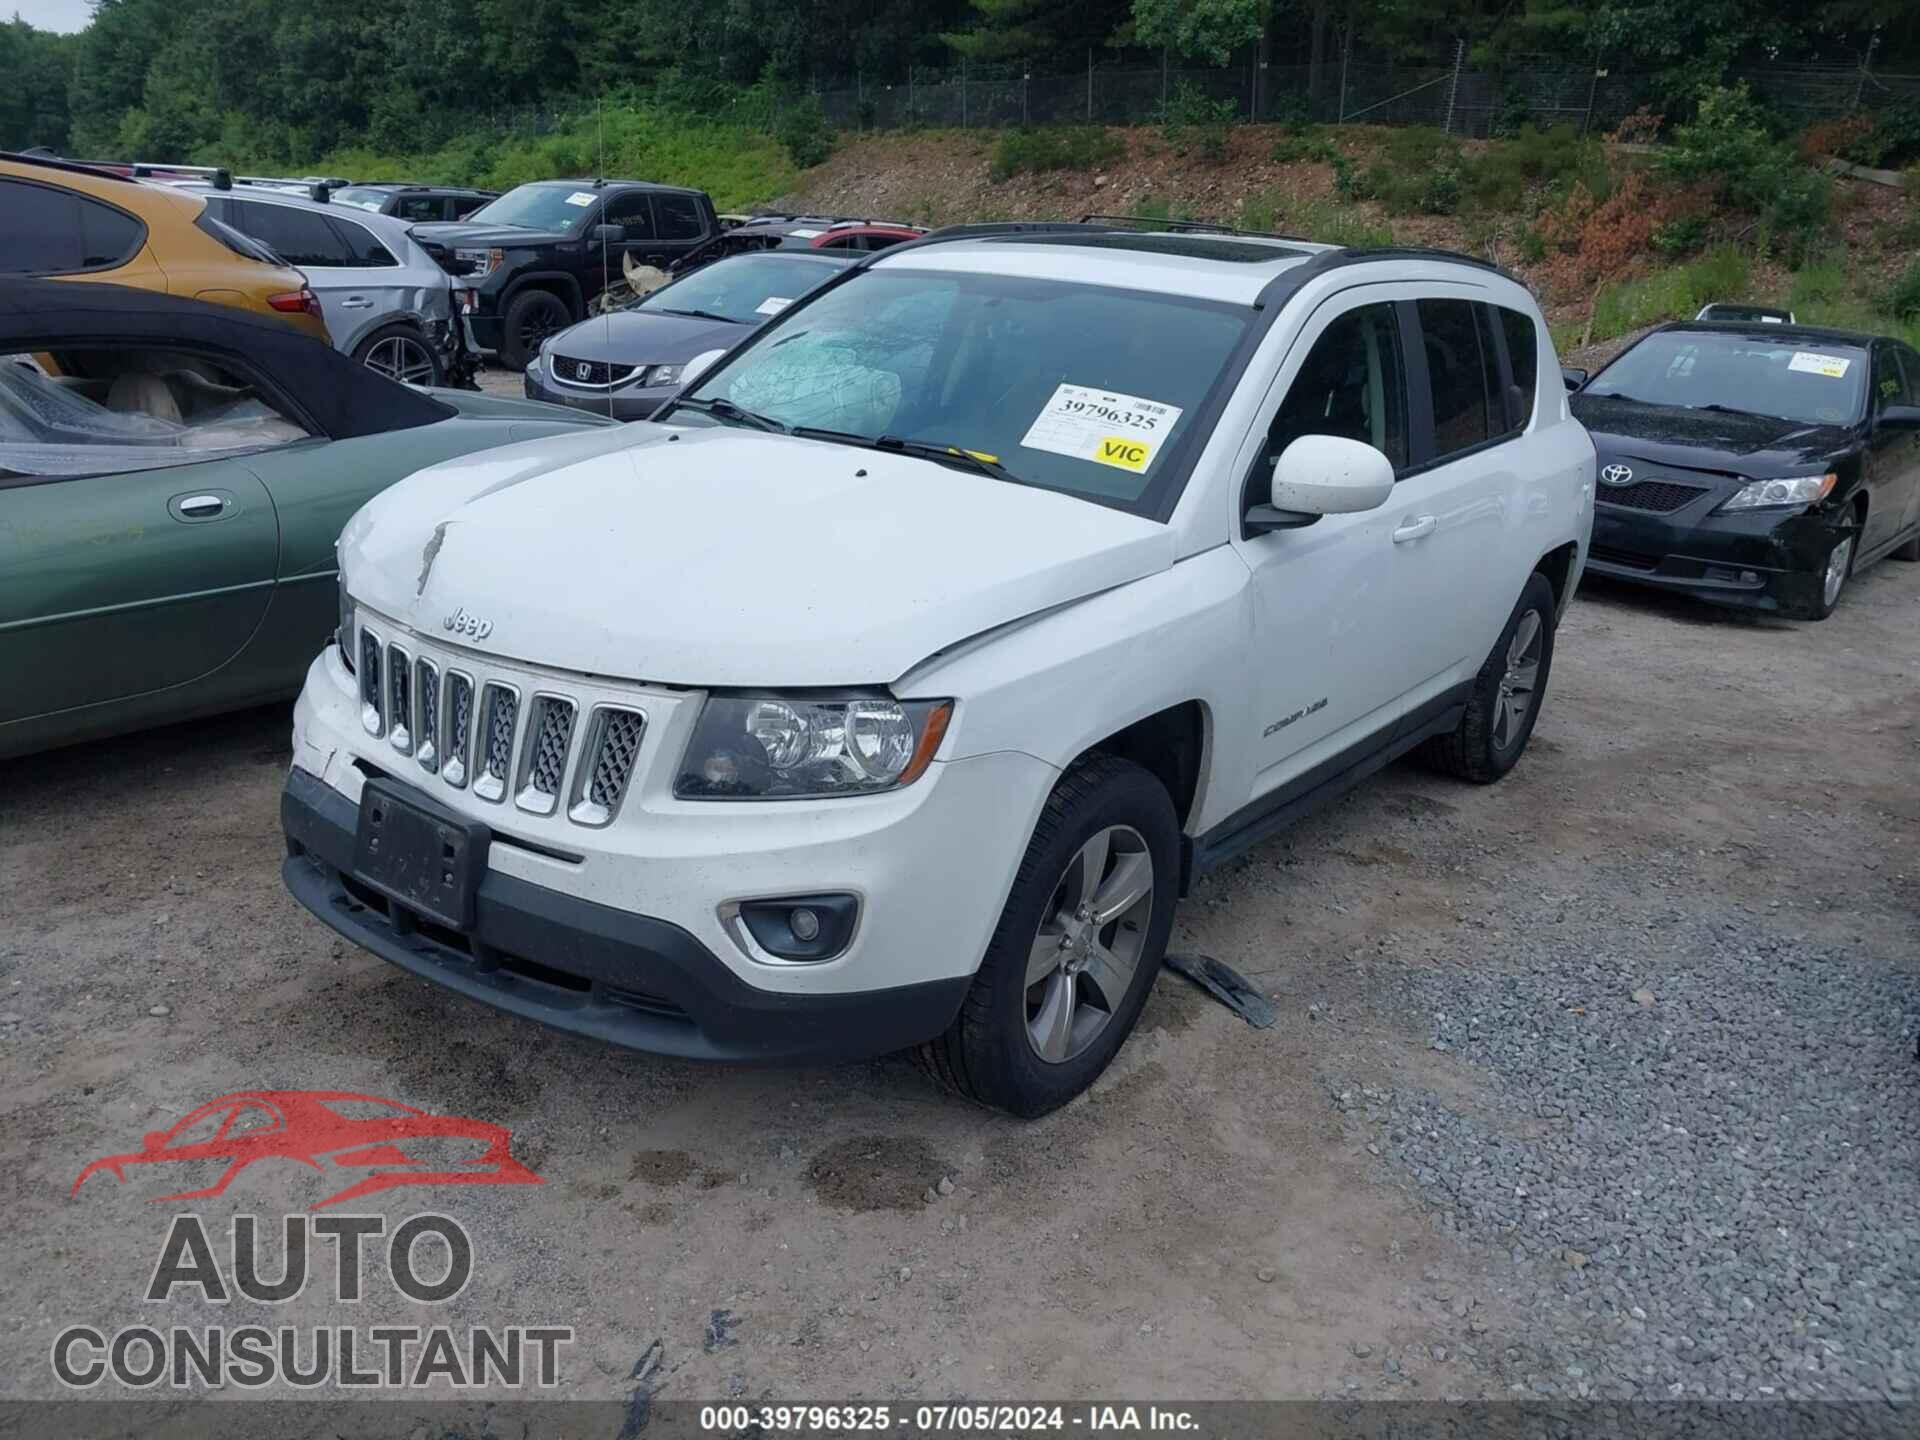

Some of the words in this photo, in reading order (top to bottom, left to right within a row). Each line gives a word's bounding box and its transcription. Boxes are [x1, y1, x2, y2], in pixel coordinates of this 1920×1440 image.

[1059, 400, 1157, 430] 39796325
[1104, 442, 1144, 462] VIC
[444, 607, 494, 642] Jeep
